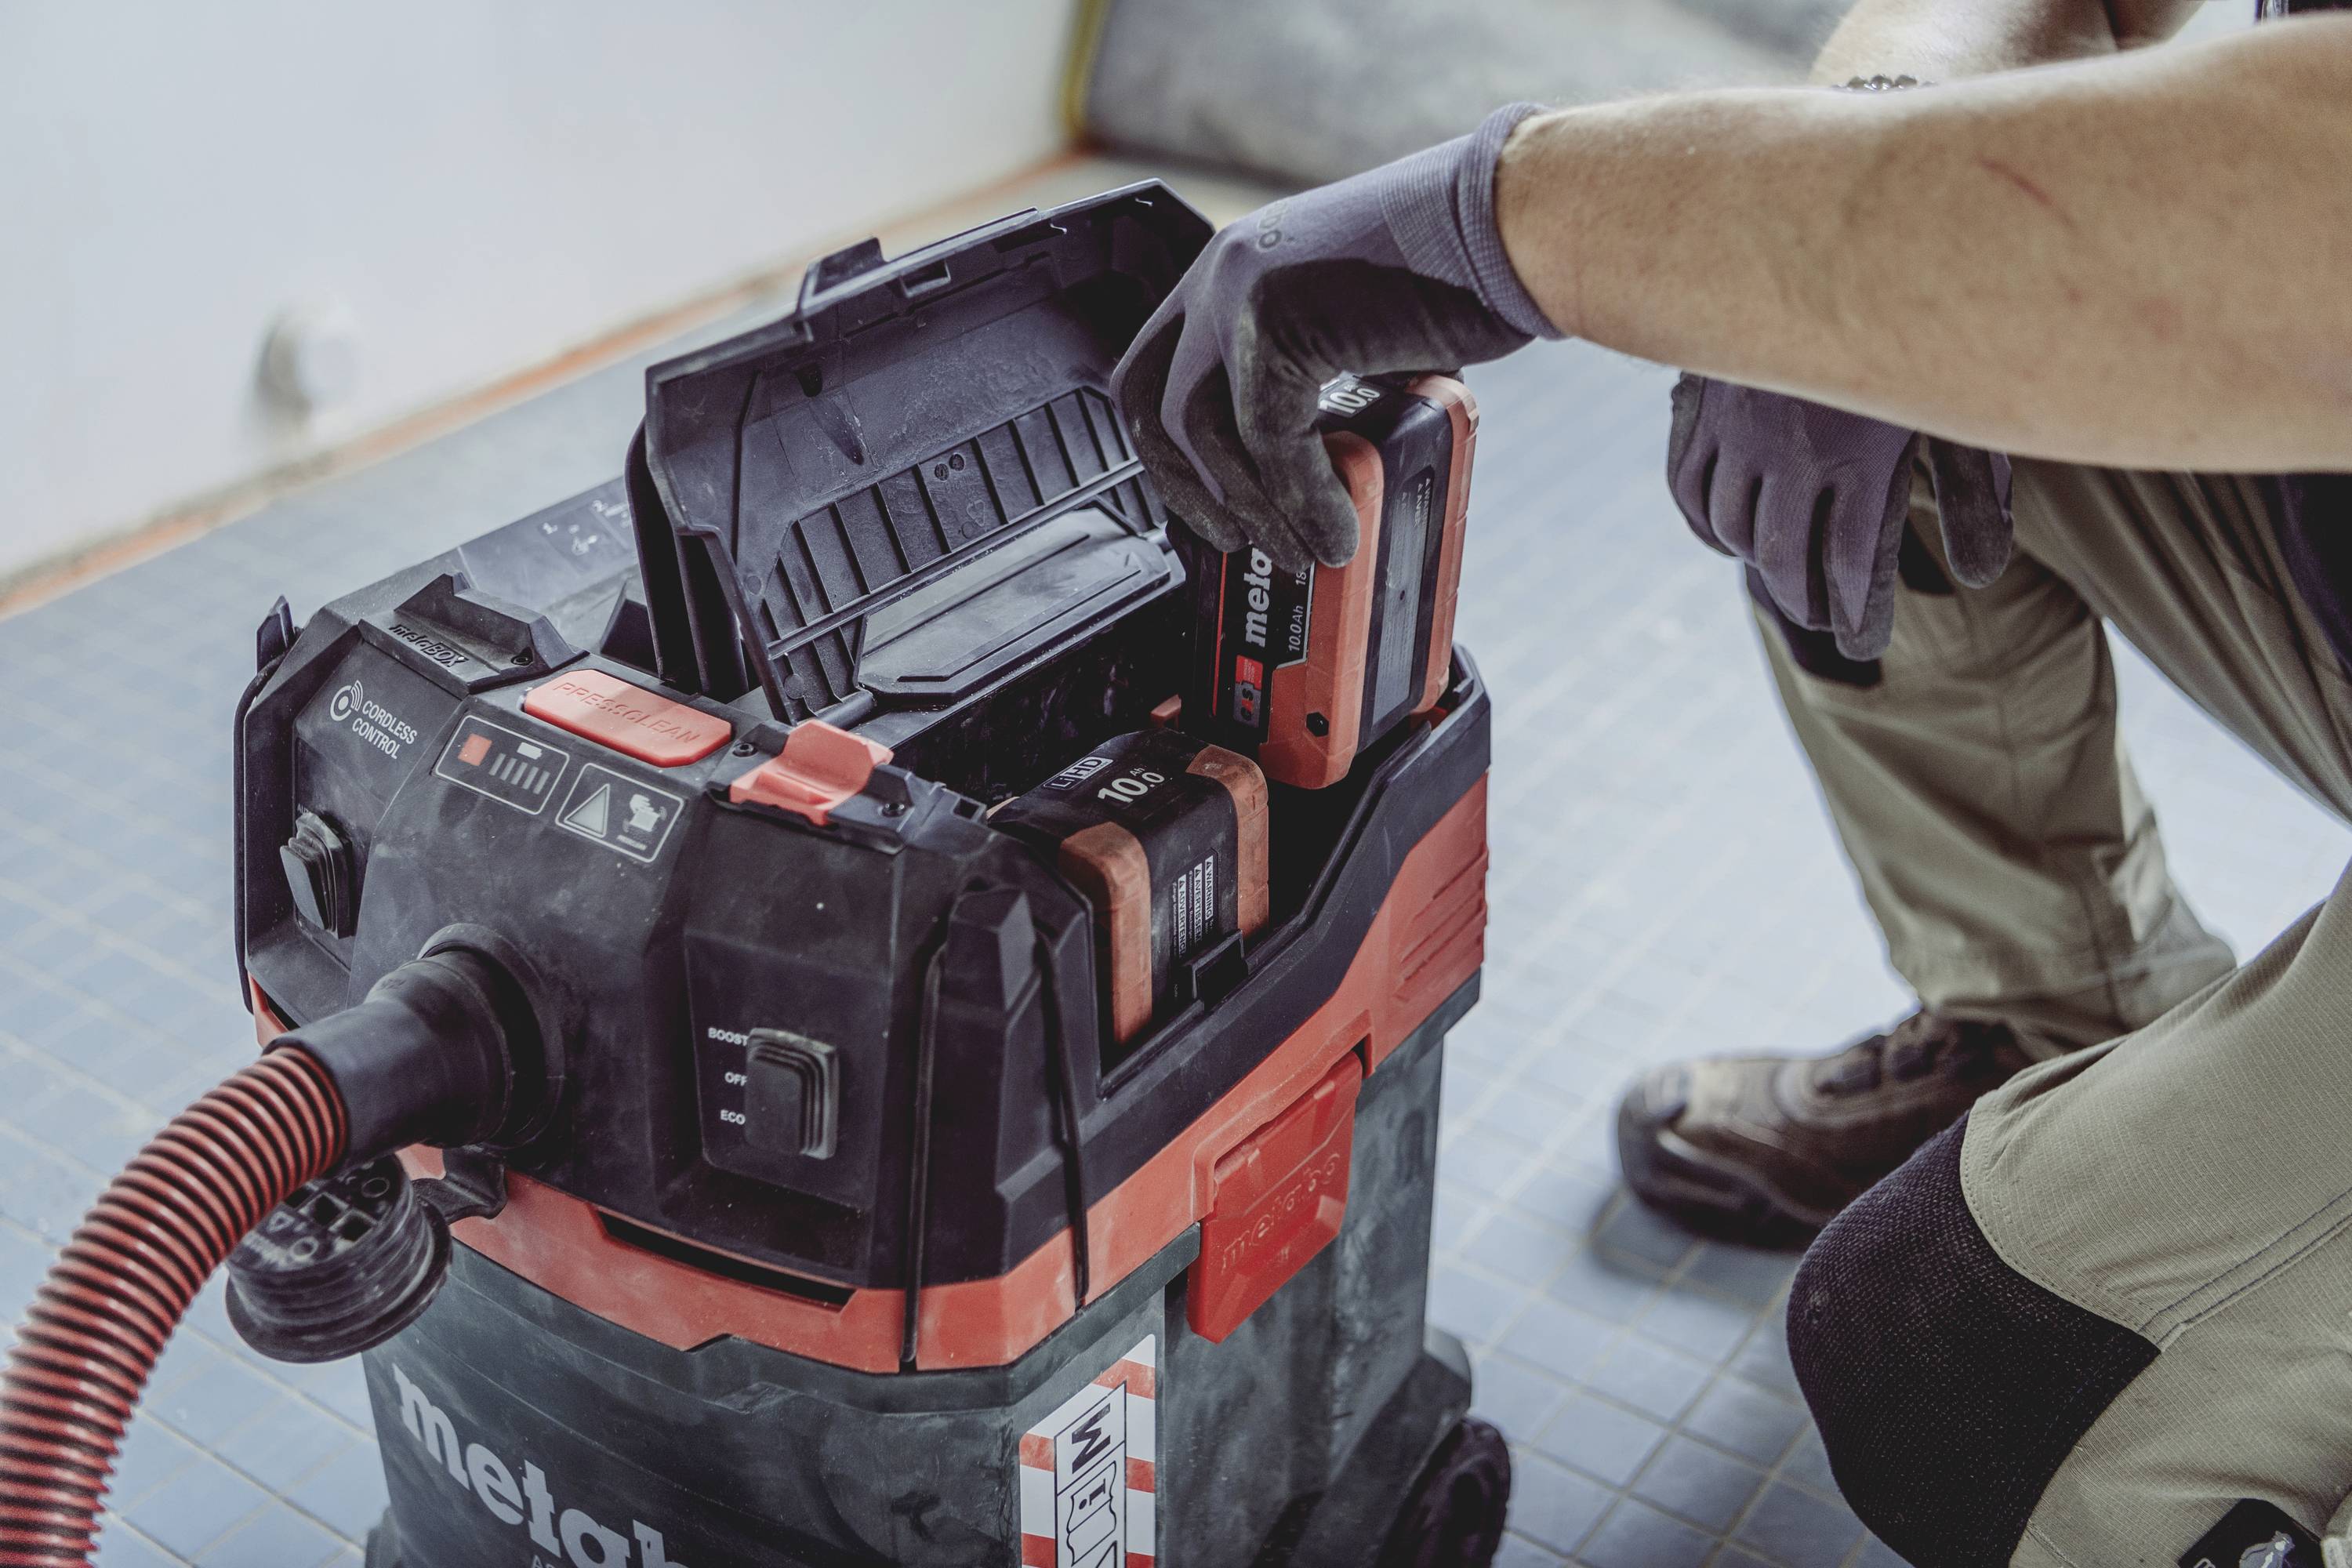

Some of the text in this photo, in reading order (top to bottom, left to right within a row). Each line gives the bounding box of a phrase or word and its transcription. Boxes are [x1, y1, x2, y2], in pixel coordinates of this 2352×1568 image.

[1319, 388, 1380, 414] 10.0
[1243, 547, 1273, 648] meta
[362, 700, 417, 744] CORDLESS
[553, 682, 701, 742] PRESSCLEAN
[352, 718, 400, 759] CONTROL
[1051, 757, 1104, 787] LiHD
[1098, 767, 1165, 803] 10.0 Ah
[709, 1028, 750, 1047] BOOST
[724, 1072, 748, 1087] OFF
[720, 1109, 746, 1125] ECO
